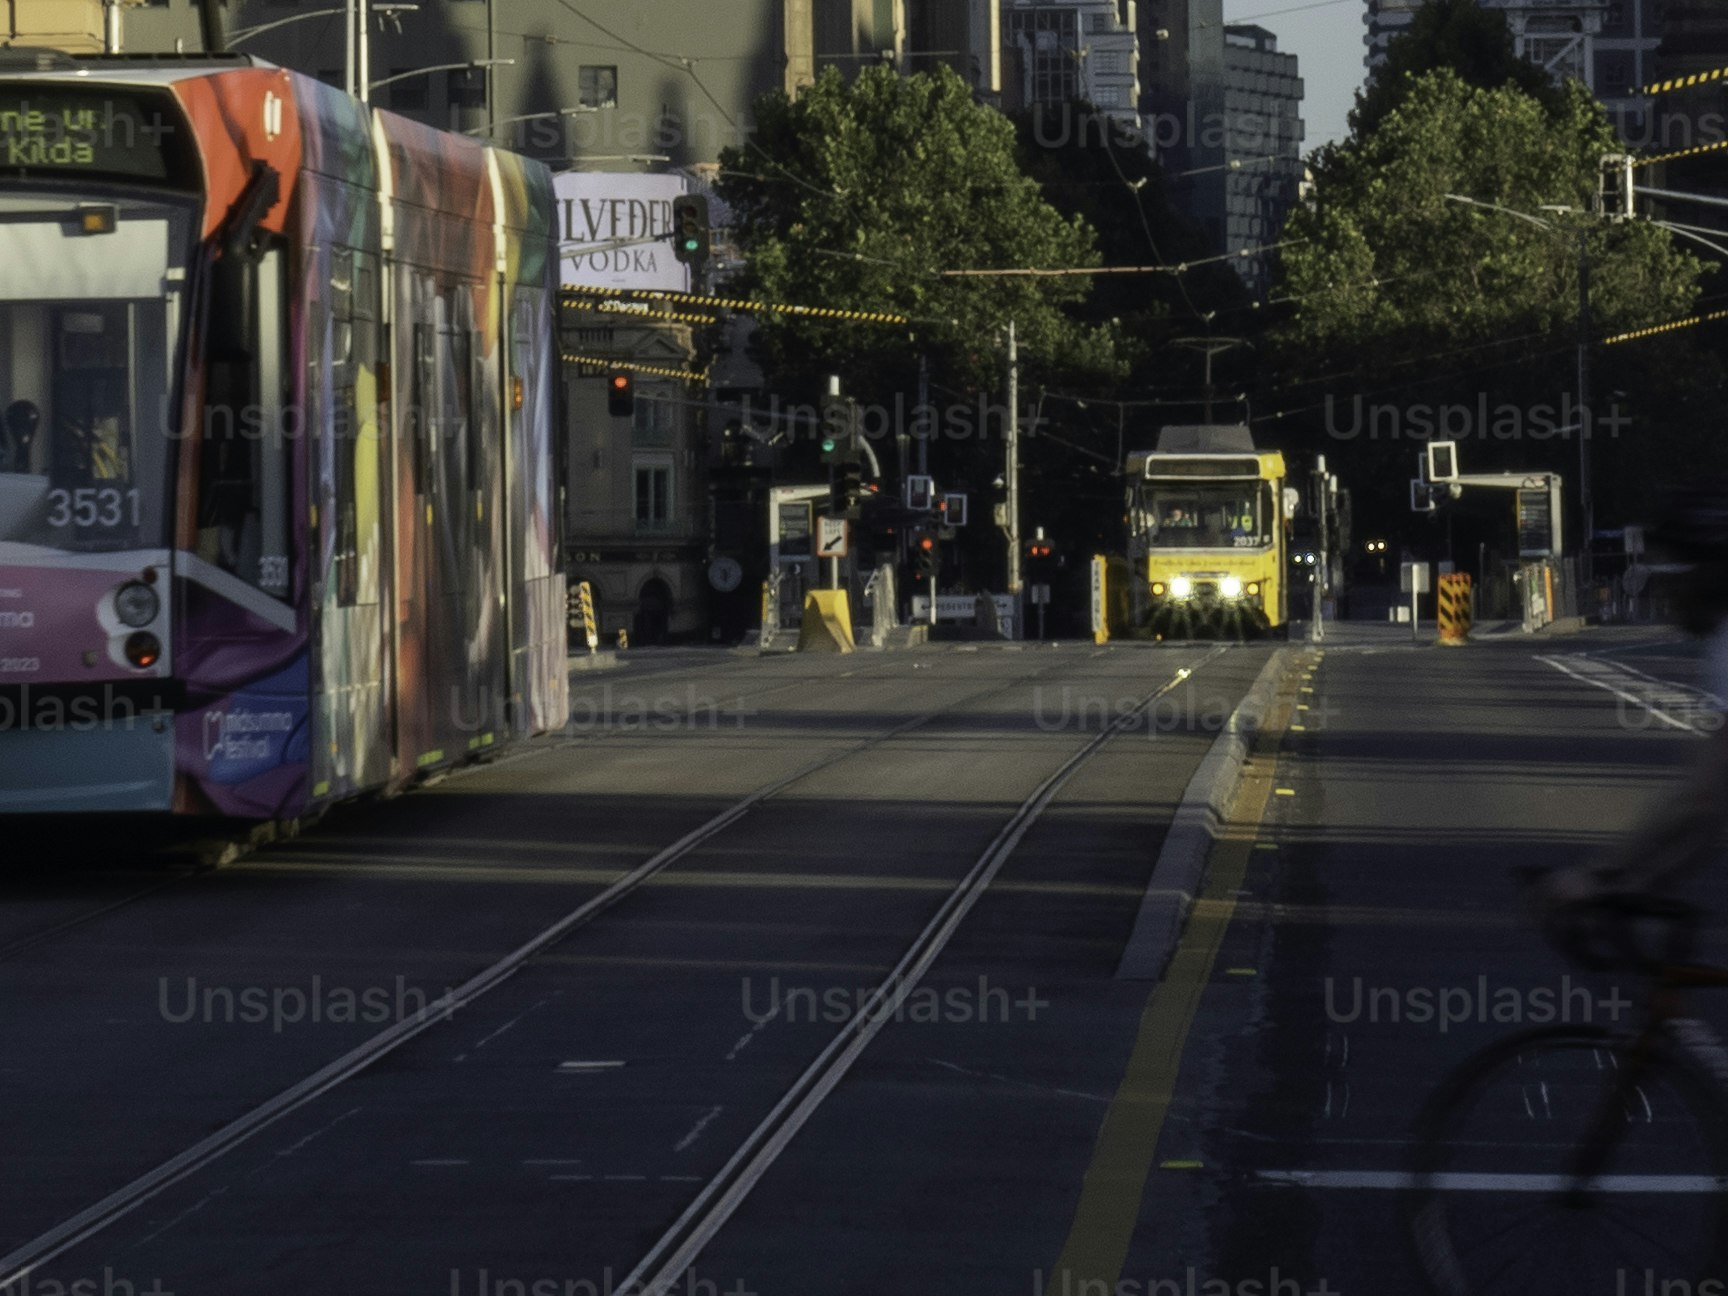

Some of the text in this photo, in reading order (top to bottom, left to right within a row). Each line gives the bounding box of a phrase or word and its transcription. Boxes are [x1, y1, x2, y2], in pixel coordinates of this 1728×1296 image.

[9, 136, 94, 165] Kilda
[556, 198, 673, 242] LVEDER
[571, 250, 658, 272] VODKA
[47, 487, 141, 527] 3531
